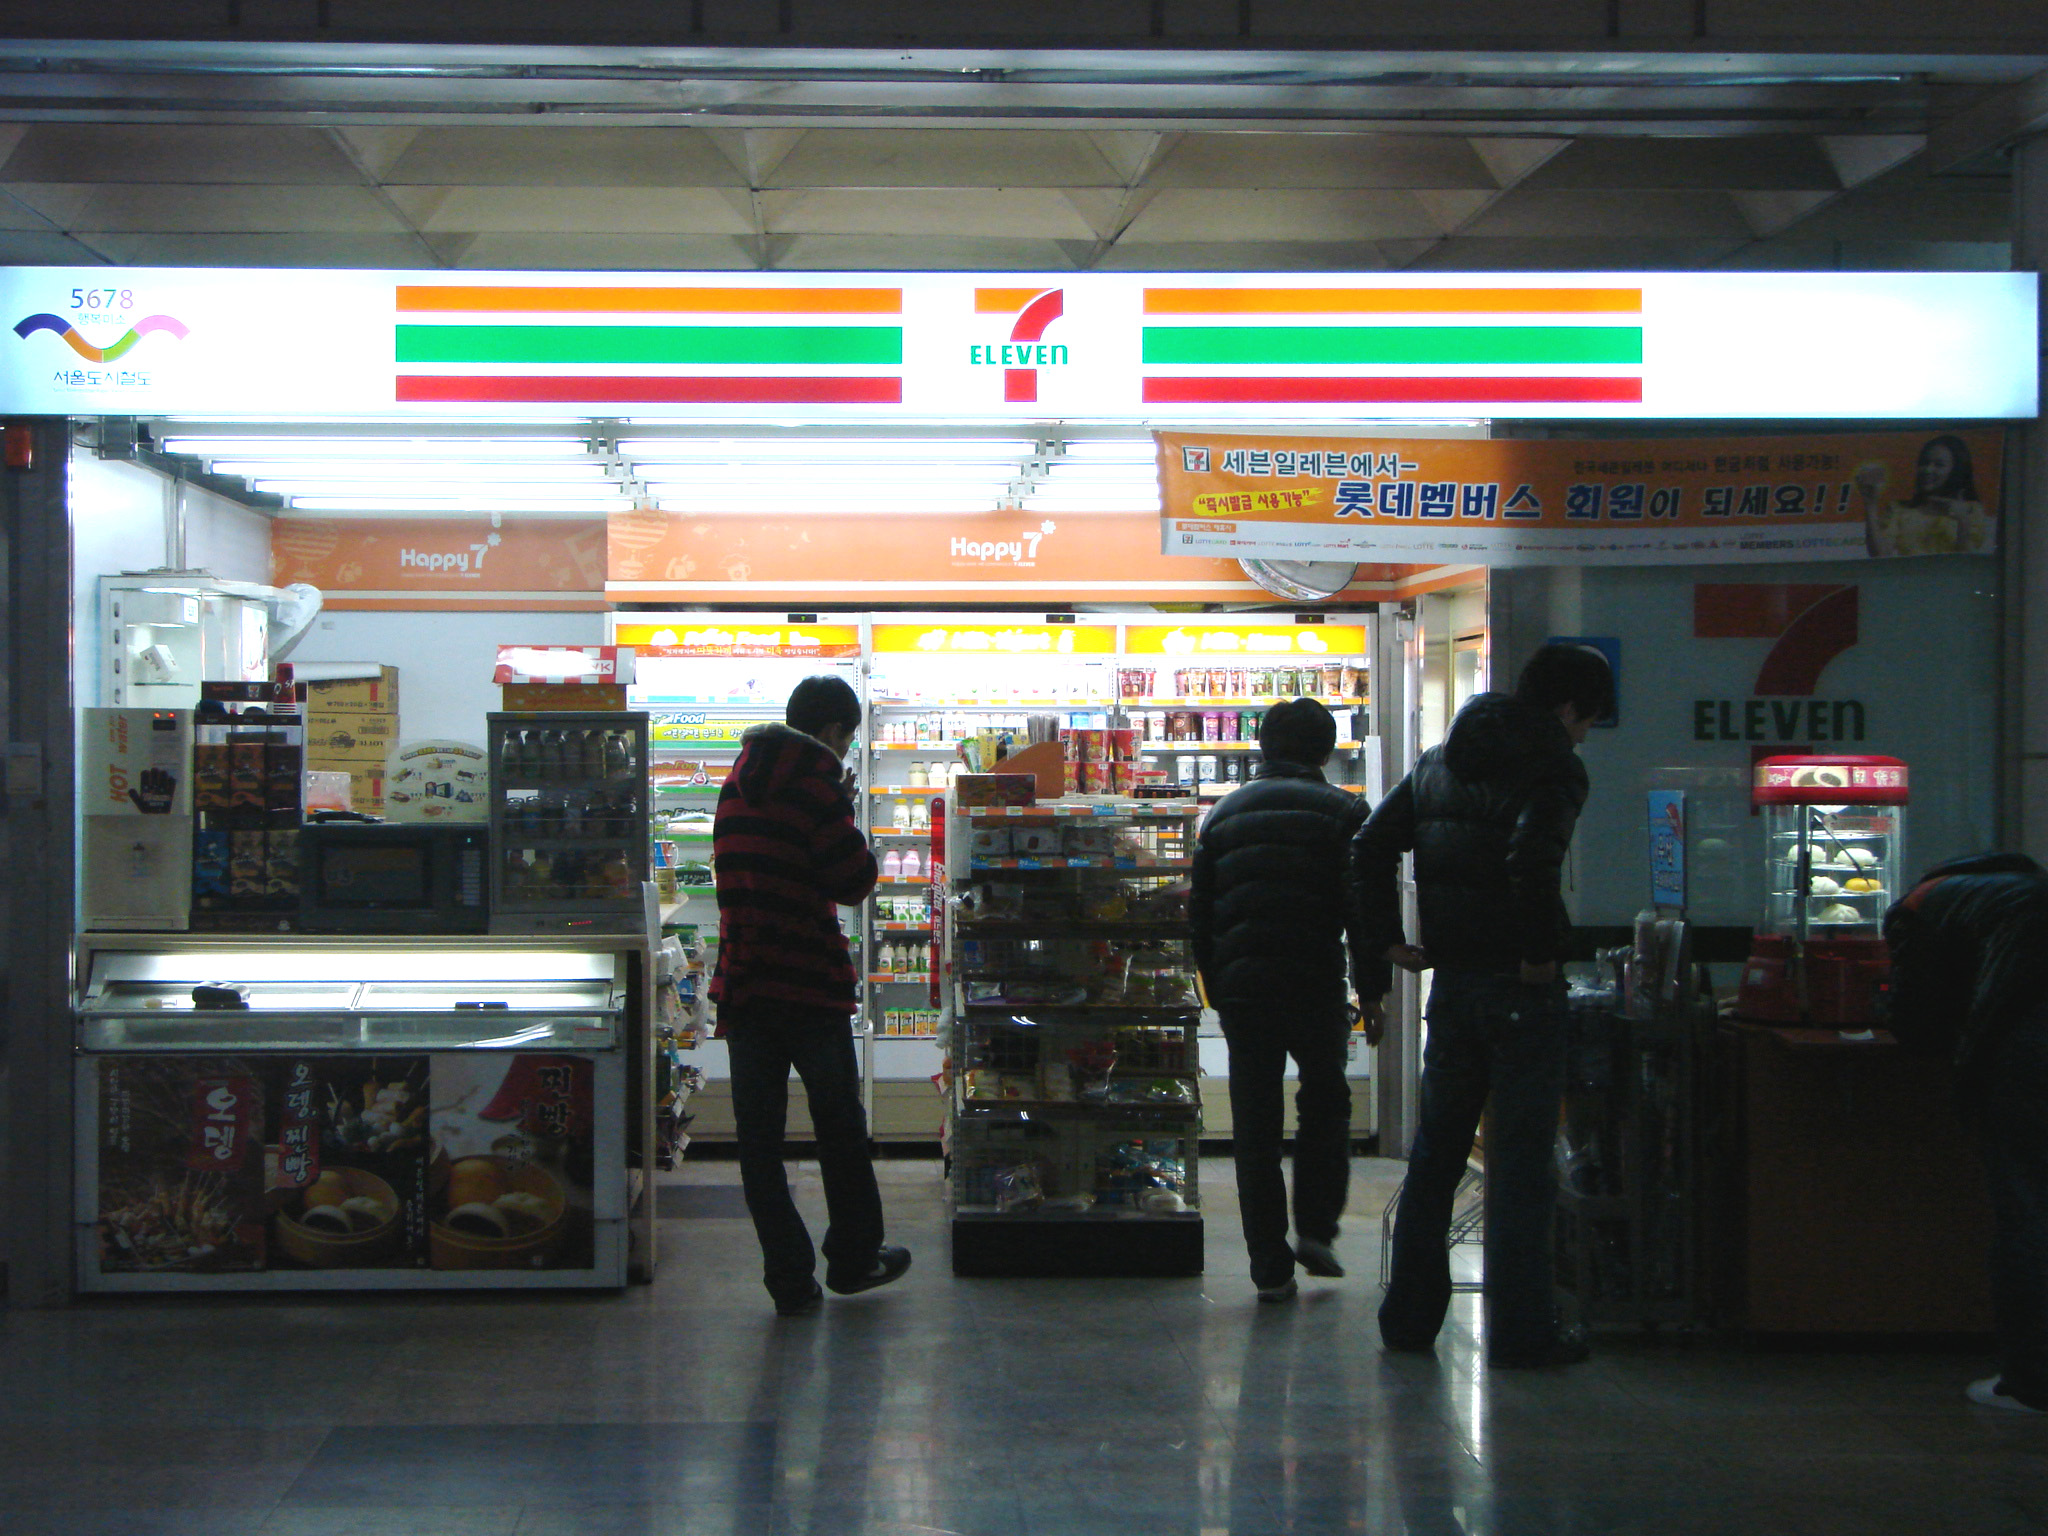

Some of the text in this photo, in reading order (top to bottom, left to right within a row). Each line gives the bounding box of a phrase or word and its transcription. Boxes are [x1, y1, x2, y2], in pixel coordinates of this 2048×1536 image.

[70, 288, 134, 309] 5678
[970, 287, 1068, 403] 7 ELEVEN
[53, 370, 153, 386] 서울도시철도
[1334, 481, 1851, 520] 롯데멤버스 회원이 되세요!!
[401, 544, 489, 571] Happy 7
[951, 531, 1043, 561] Happy 7
[1740, 540, 1794, 549] MEMBERS
[673, 712, 706, 724] Food
[1694, 700, 1864, 741] ELEVEN
[109, 715, 129, 803] HOT water
[932, 861, 945, 912] Energizer
[205, 1086, 238, 1160] 오뎅
